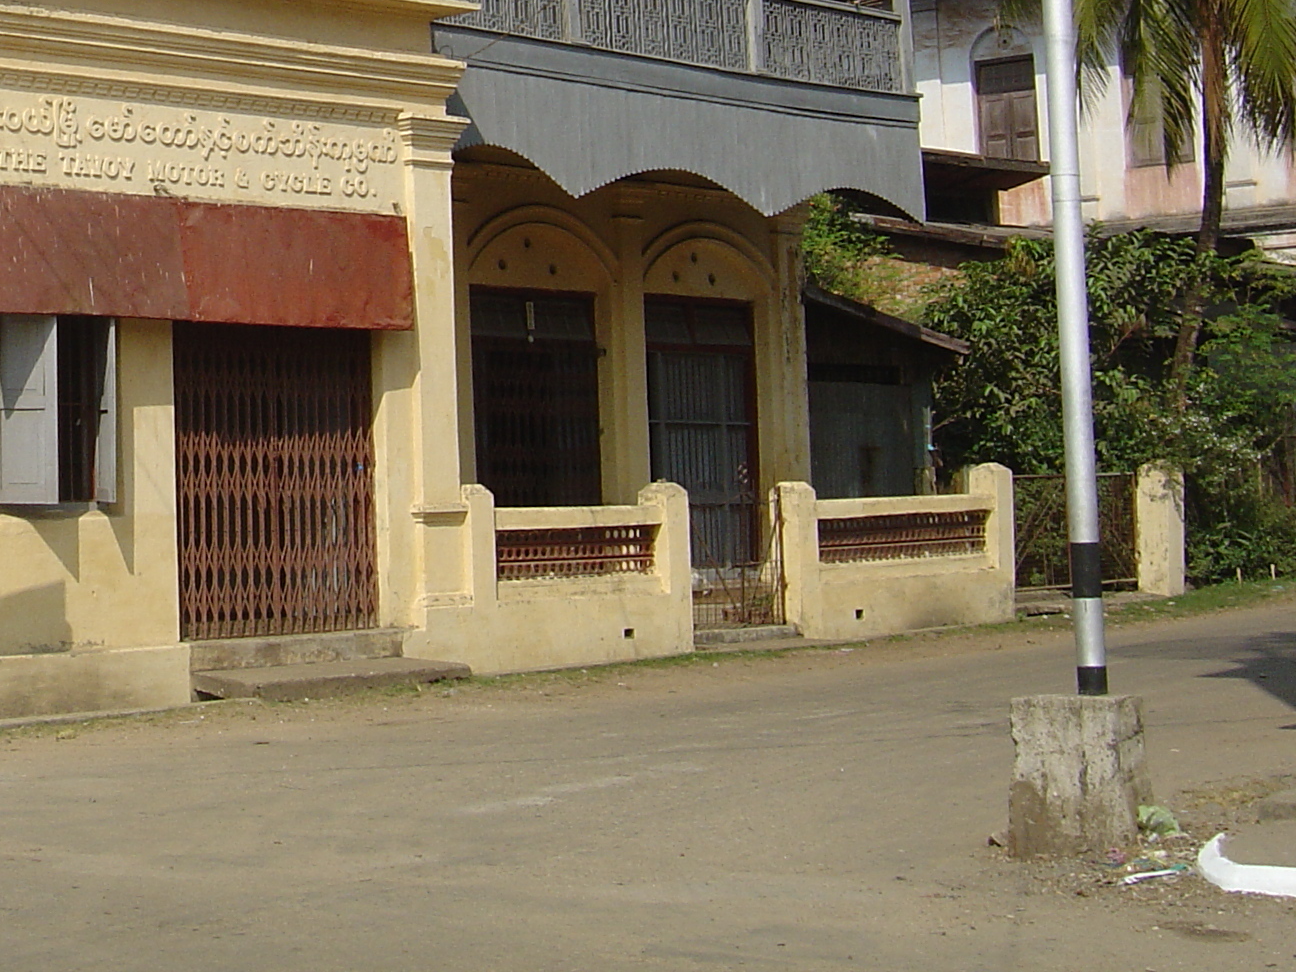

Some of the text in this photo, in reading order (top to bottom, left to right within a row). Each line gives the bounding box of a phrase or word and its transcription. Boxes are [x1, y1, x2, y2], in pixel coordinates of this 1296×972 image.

[58, 152, 135, 181] TAVOY
[148, 160, 225, 187] MOTOR
[235, 169, 250, 188] &
[261, 171, 332, 196] CYCLE
[340, 176, 377, 198] CO.
